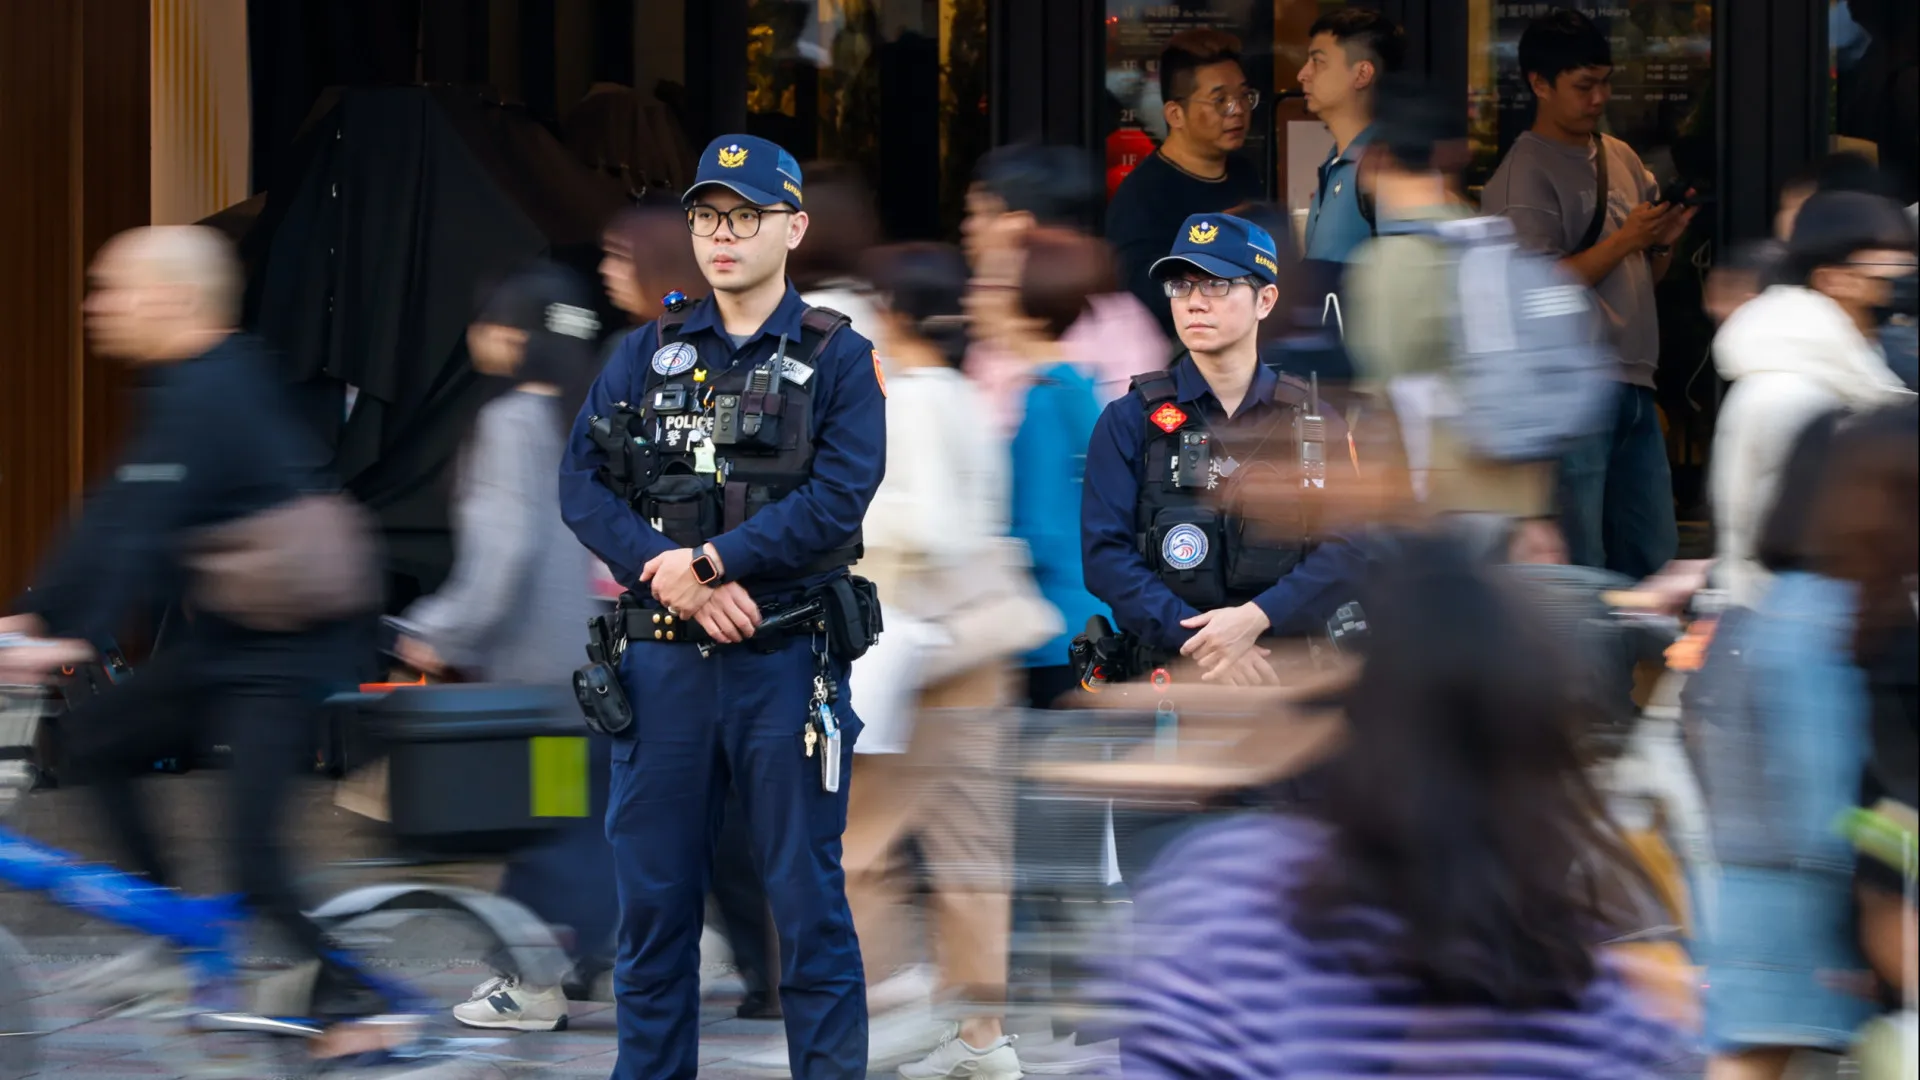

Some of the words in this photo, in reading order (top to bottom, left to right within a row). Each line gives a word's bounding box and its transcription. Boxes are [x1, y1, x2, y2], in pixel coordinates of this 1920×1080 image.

[1120, 109, 1136, 122] 2F
[1121, 154, 1137, 166] 1F
[665, 415, 714, 431] POLICE
